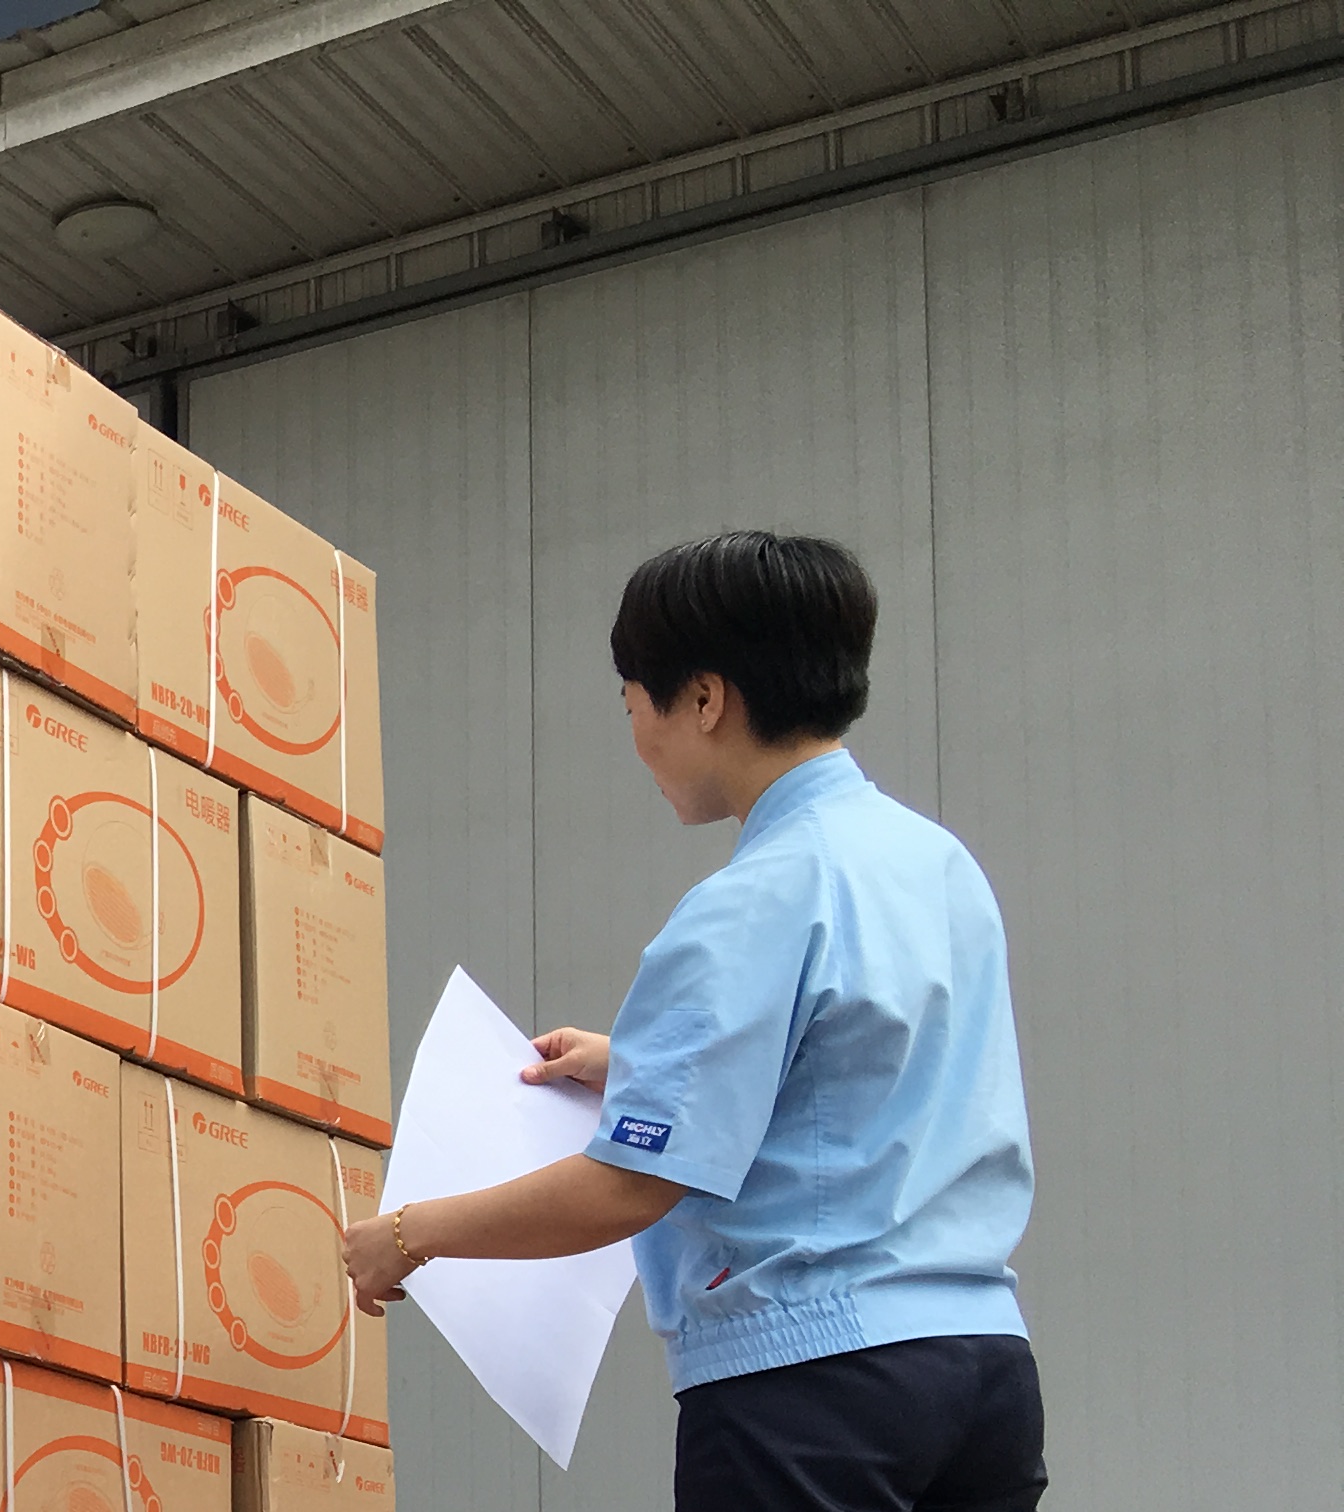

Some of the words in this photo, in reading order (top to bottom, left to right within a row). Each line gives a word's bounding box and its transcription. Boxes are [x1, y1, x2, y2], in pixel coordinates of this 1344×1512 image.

[99, 423, 127, 448] GREE
[45, 716, 88, 753] GREE
[185, 788, 231, 834] 电暖器
[83, 1077, 109, 1099] GREE
[209, 1121, 248, 1149] GREE
[622, 1119, 669, 1137] HIGHLY
[627, 1132, 652, 1147] 海立
